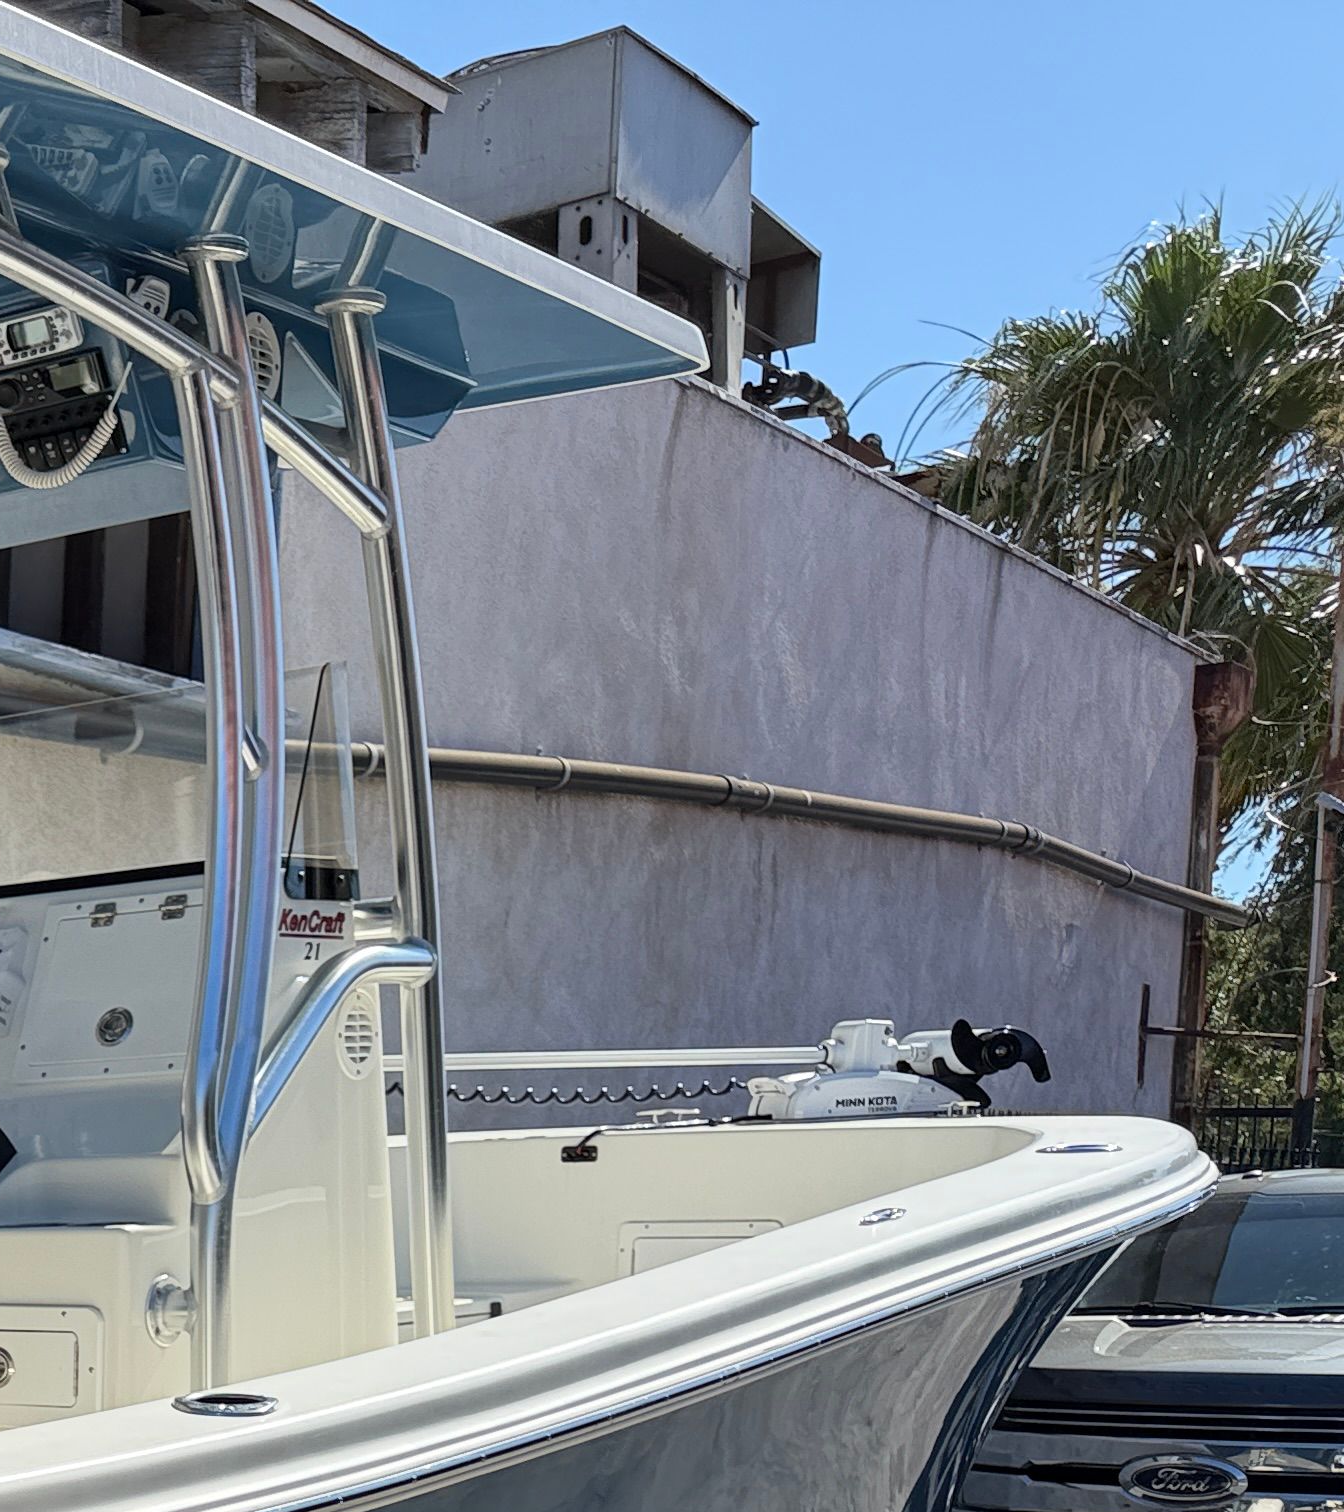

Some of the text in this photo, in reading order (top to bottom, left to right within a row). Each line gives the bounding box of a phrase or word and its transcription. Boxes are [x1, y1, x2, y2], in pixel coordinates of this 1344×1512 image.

[278, 908, 345, 934] KenCraft
[303, 941, 321, 960] 21
[835, 1096, 898, 1108] MINN KOTA
[1151, 1467, 1213, 1492] Ford
